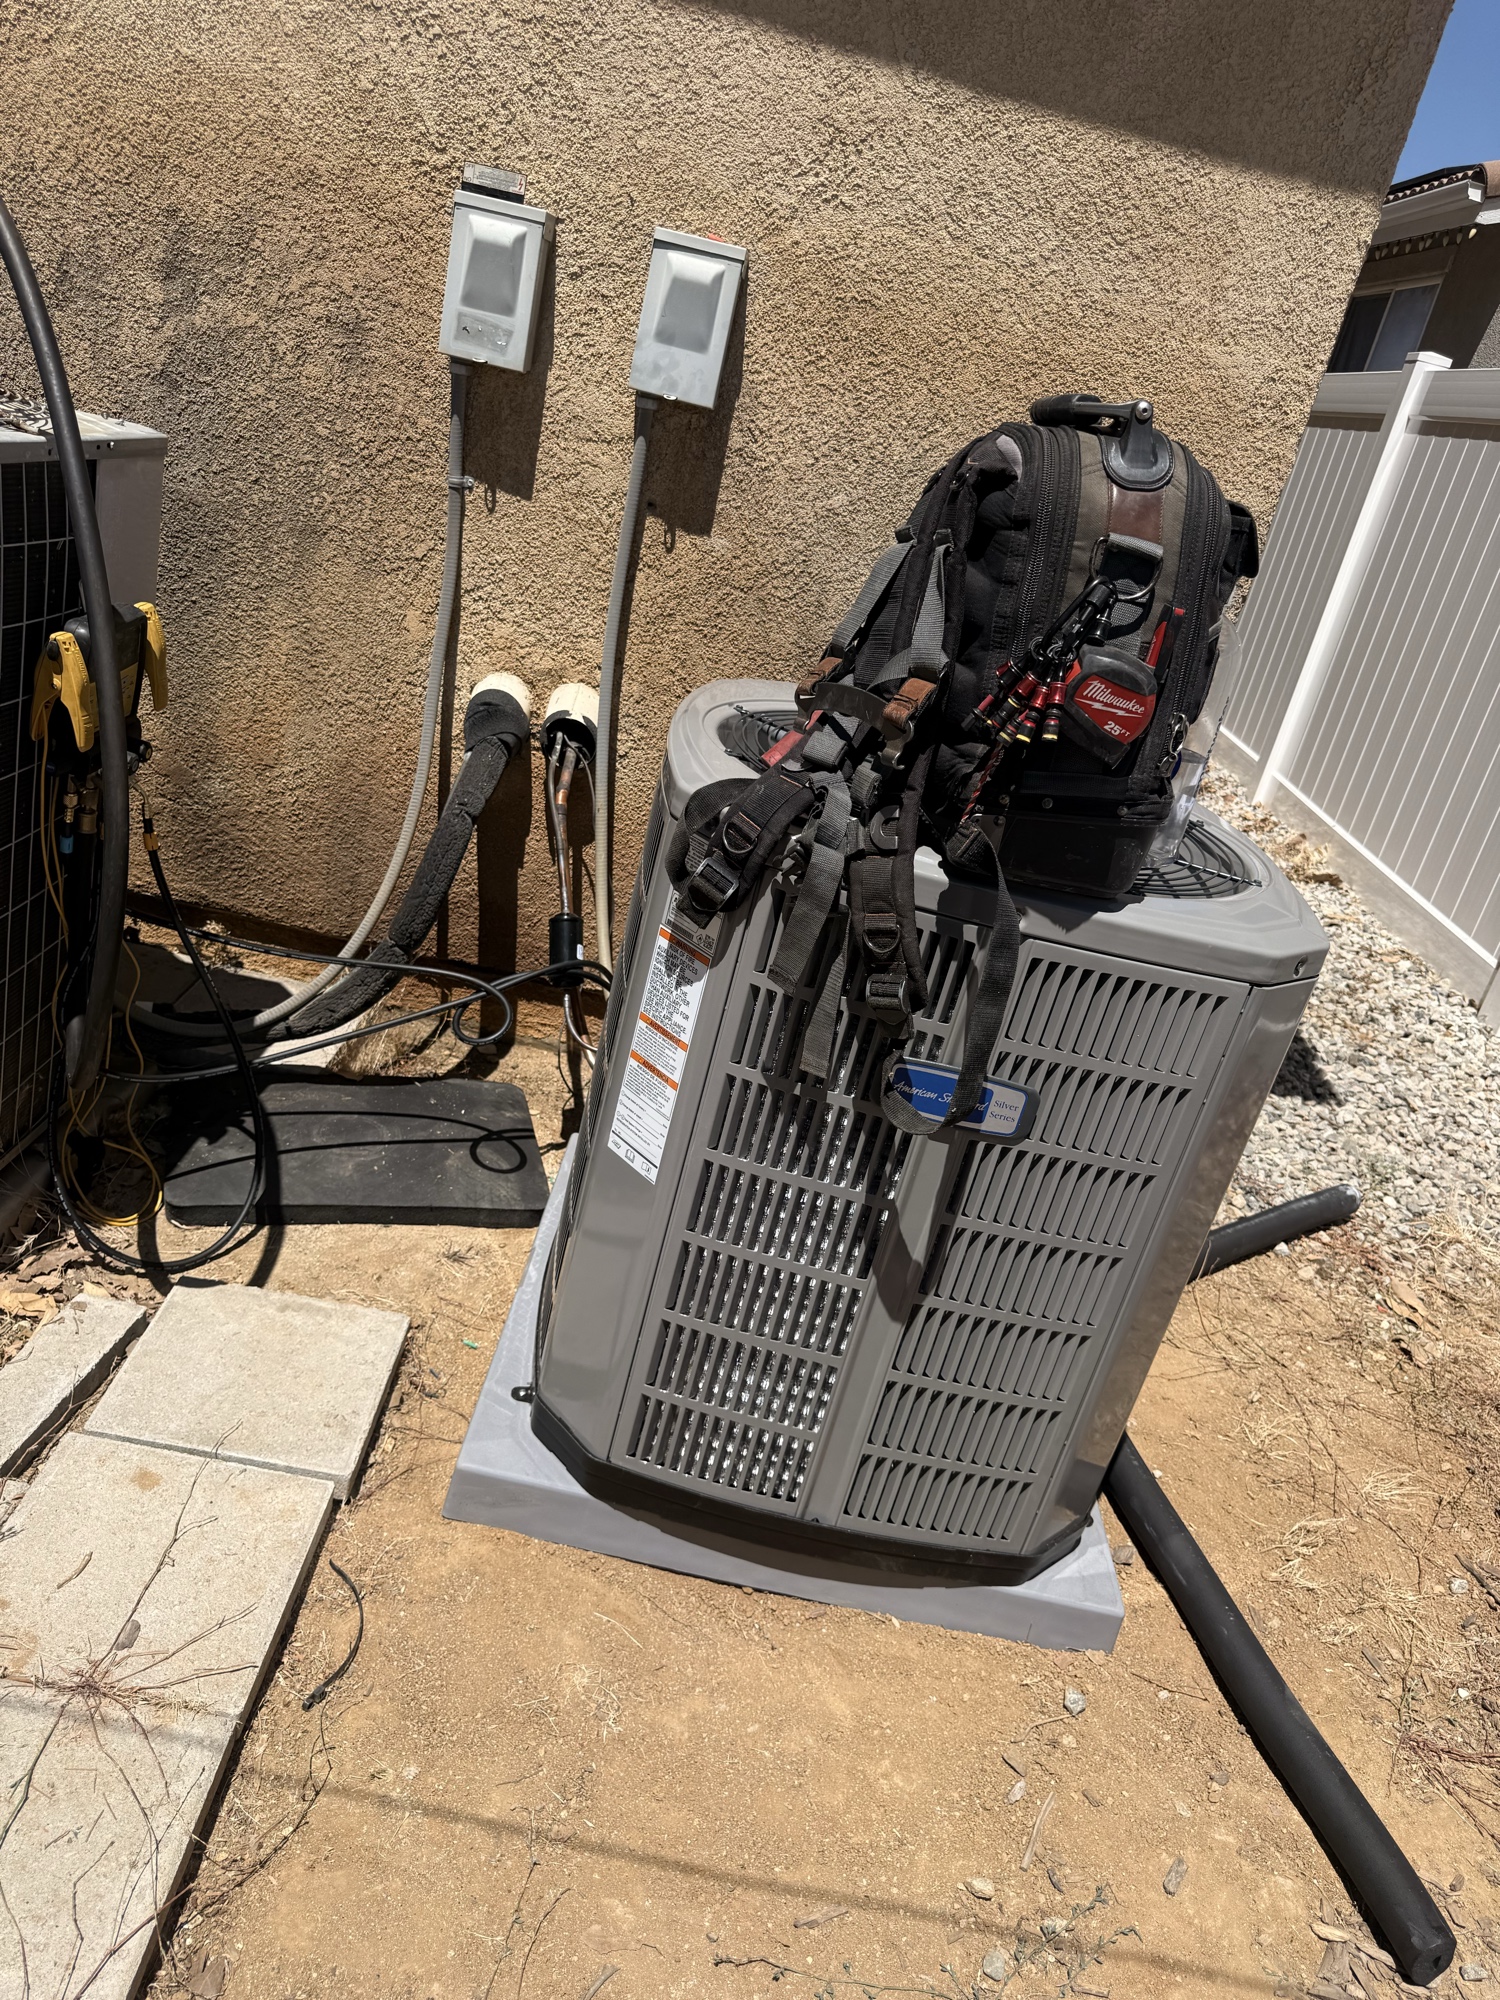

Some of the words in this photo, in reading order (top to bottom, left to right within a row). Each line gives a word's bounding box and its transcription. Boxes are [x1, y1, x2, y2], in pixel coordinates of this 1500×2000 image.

[1083, 680, 1145, 714] Milwaukee
[669, 943, 678, 954] RISK
[679, 950, 685, 958] OF
[685, 954, 695, 965] FIRE
[672, 968, 693, 986] SOURCES
[679, 988, 687, 998] THE
[665, 1007, 674, 1018] THE
[642, 1059, 668, 1083] ADVERTENCIA
[894, 1080, 938, 1099] American
[938, 1092, 989, 1112] Strd
[994, 1100, 1020, 1112] Silver
[989, 1111, 1016, 1123] Series
